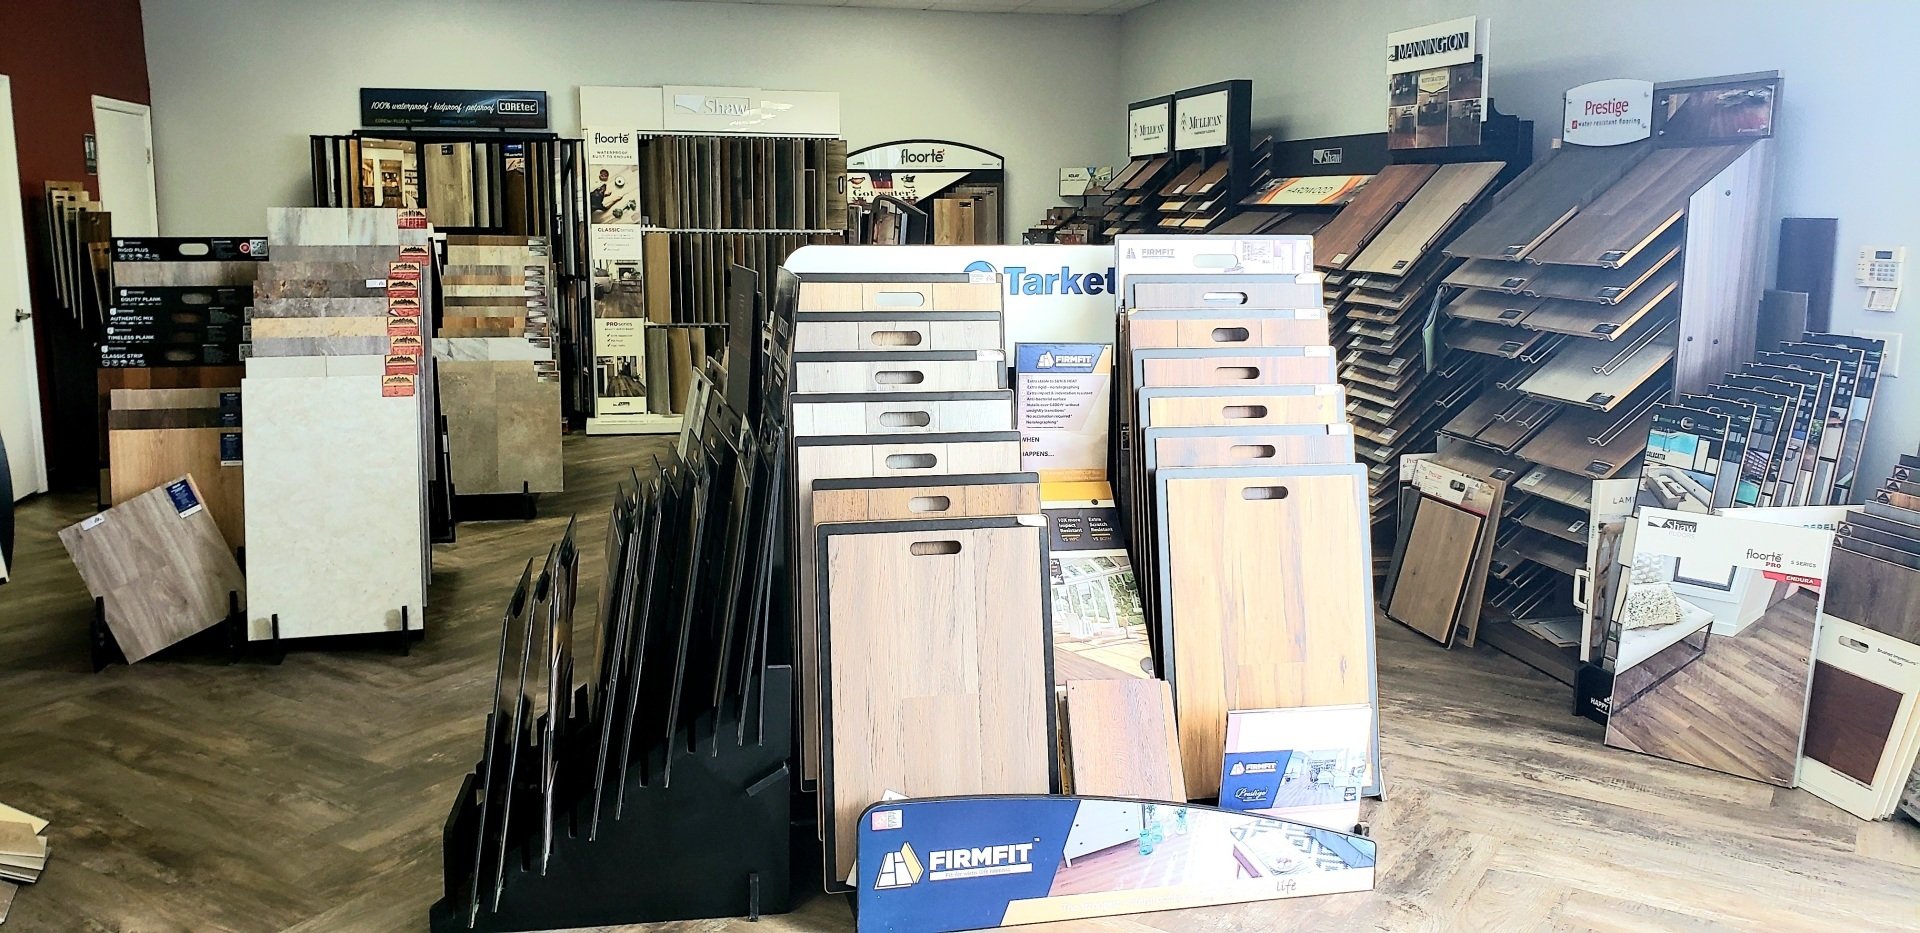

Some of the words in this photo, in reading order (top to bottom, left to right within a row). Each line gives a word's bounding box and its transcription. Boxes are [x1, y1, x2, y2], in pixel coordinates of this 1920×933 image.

[1399, 32, 1469, 59] MANNINGTON
[371, 101, 391, 110] 100%
[392, 102, 429, 113] waterproof
[433, 101, 463, 114] kidproof
[465, 103, 495, 114] petproof
[499, 102, 536, 112] COREtec
[704, 98, 747, 115] Shaw
[1585, 97, 1629, 117] Prestige
[1189, 115, 1222, 130] MULLICAN
[1323, 150, 1341, 164] Shaw
[852, 189, 874, 197] Got
[1141, 248, 1175, 256] FIRMFIT
[1055, 354, 1093, 364] FIRMFIT
[1666, 520, 1697, 533] Shaw
[1765, 561, 1782, 569] PRO
[1786, 575, 1814, 584] ENDURA
[1590, 696, 1609, 711] HAPPY
[929, 842, 1033, 871] FIRMFIT
